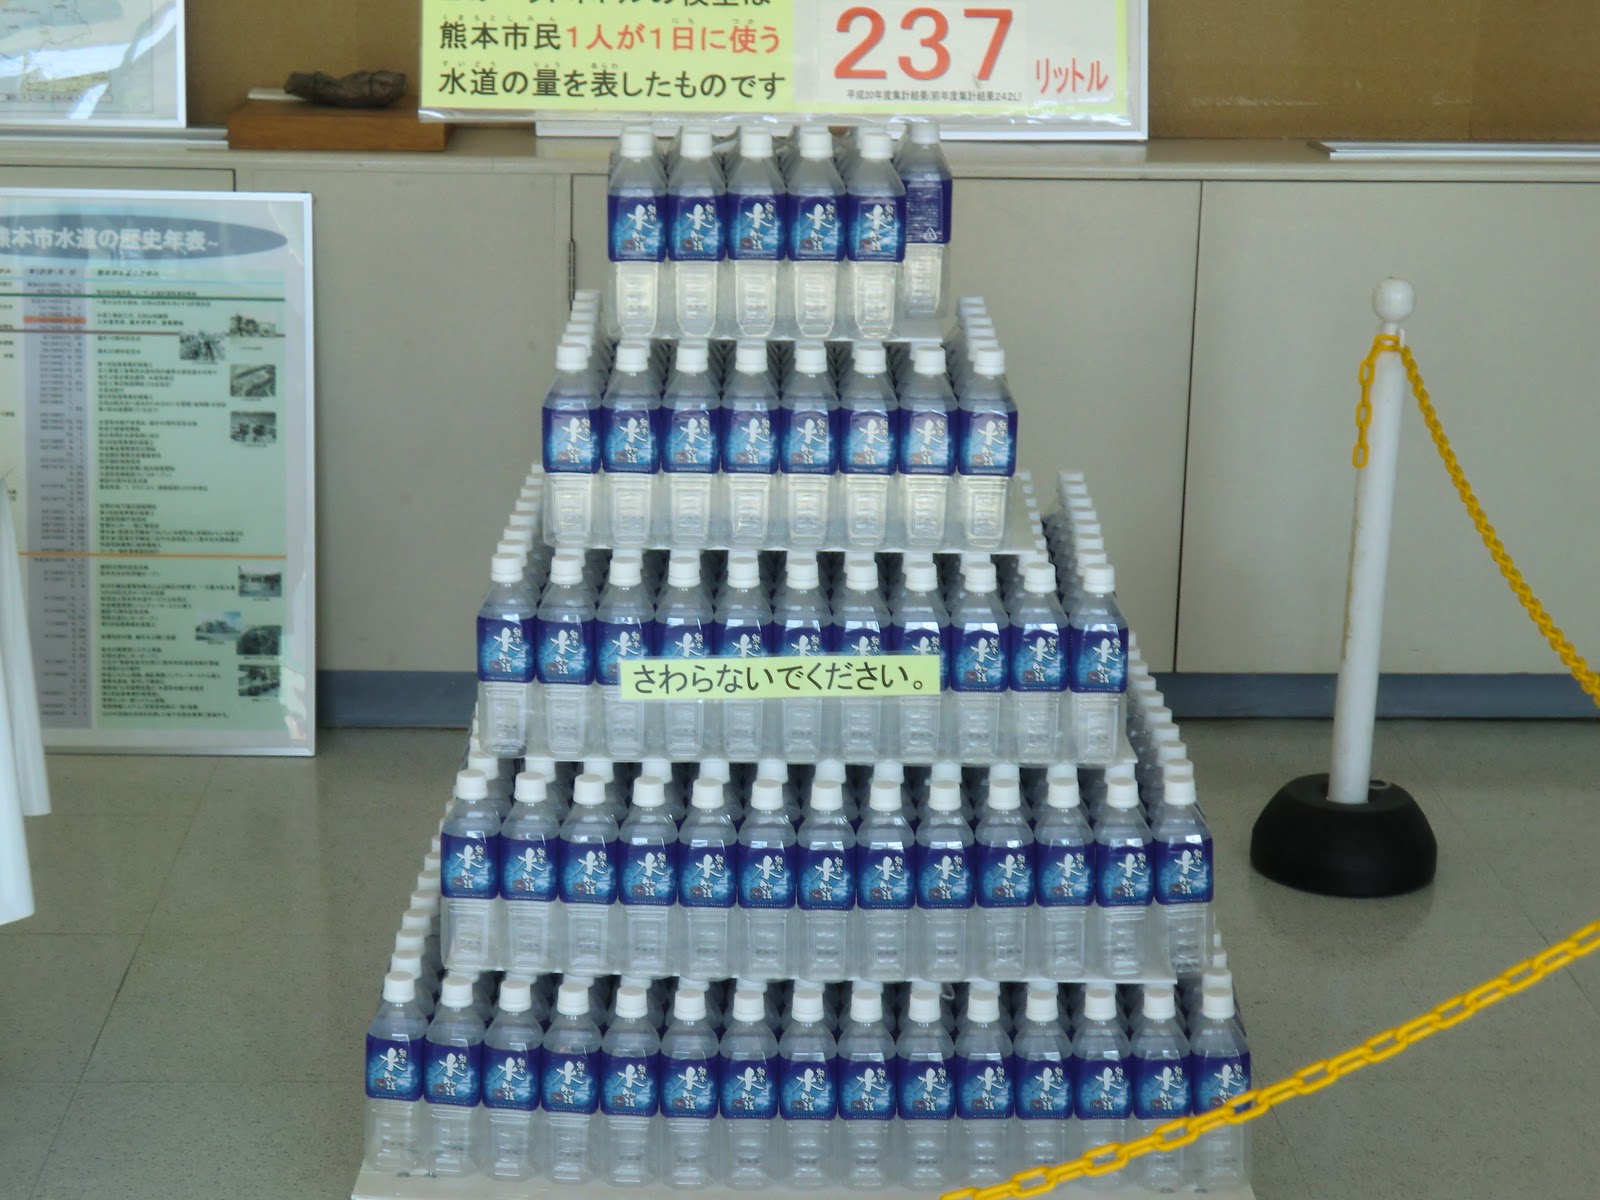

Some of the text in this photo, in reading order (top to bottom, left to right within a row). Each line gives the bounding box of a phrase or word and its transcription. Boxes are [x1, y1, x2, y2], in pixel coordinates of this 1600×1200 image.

[439, 21, 780, 52] 熊本市民1人が1日に使う
[834, 7, 1013, 80] 237
[438, 67, 785, 98] 水道の量を表したものです
[1036, 58, 1109, 94] リットル
[633, 661, 923, 694] さわらないでください。
